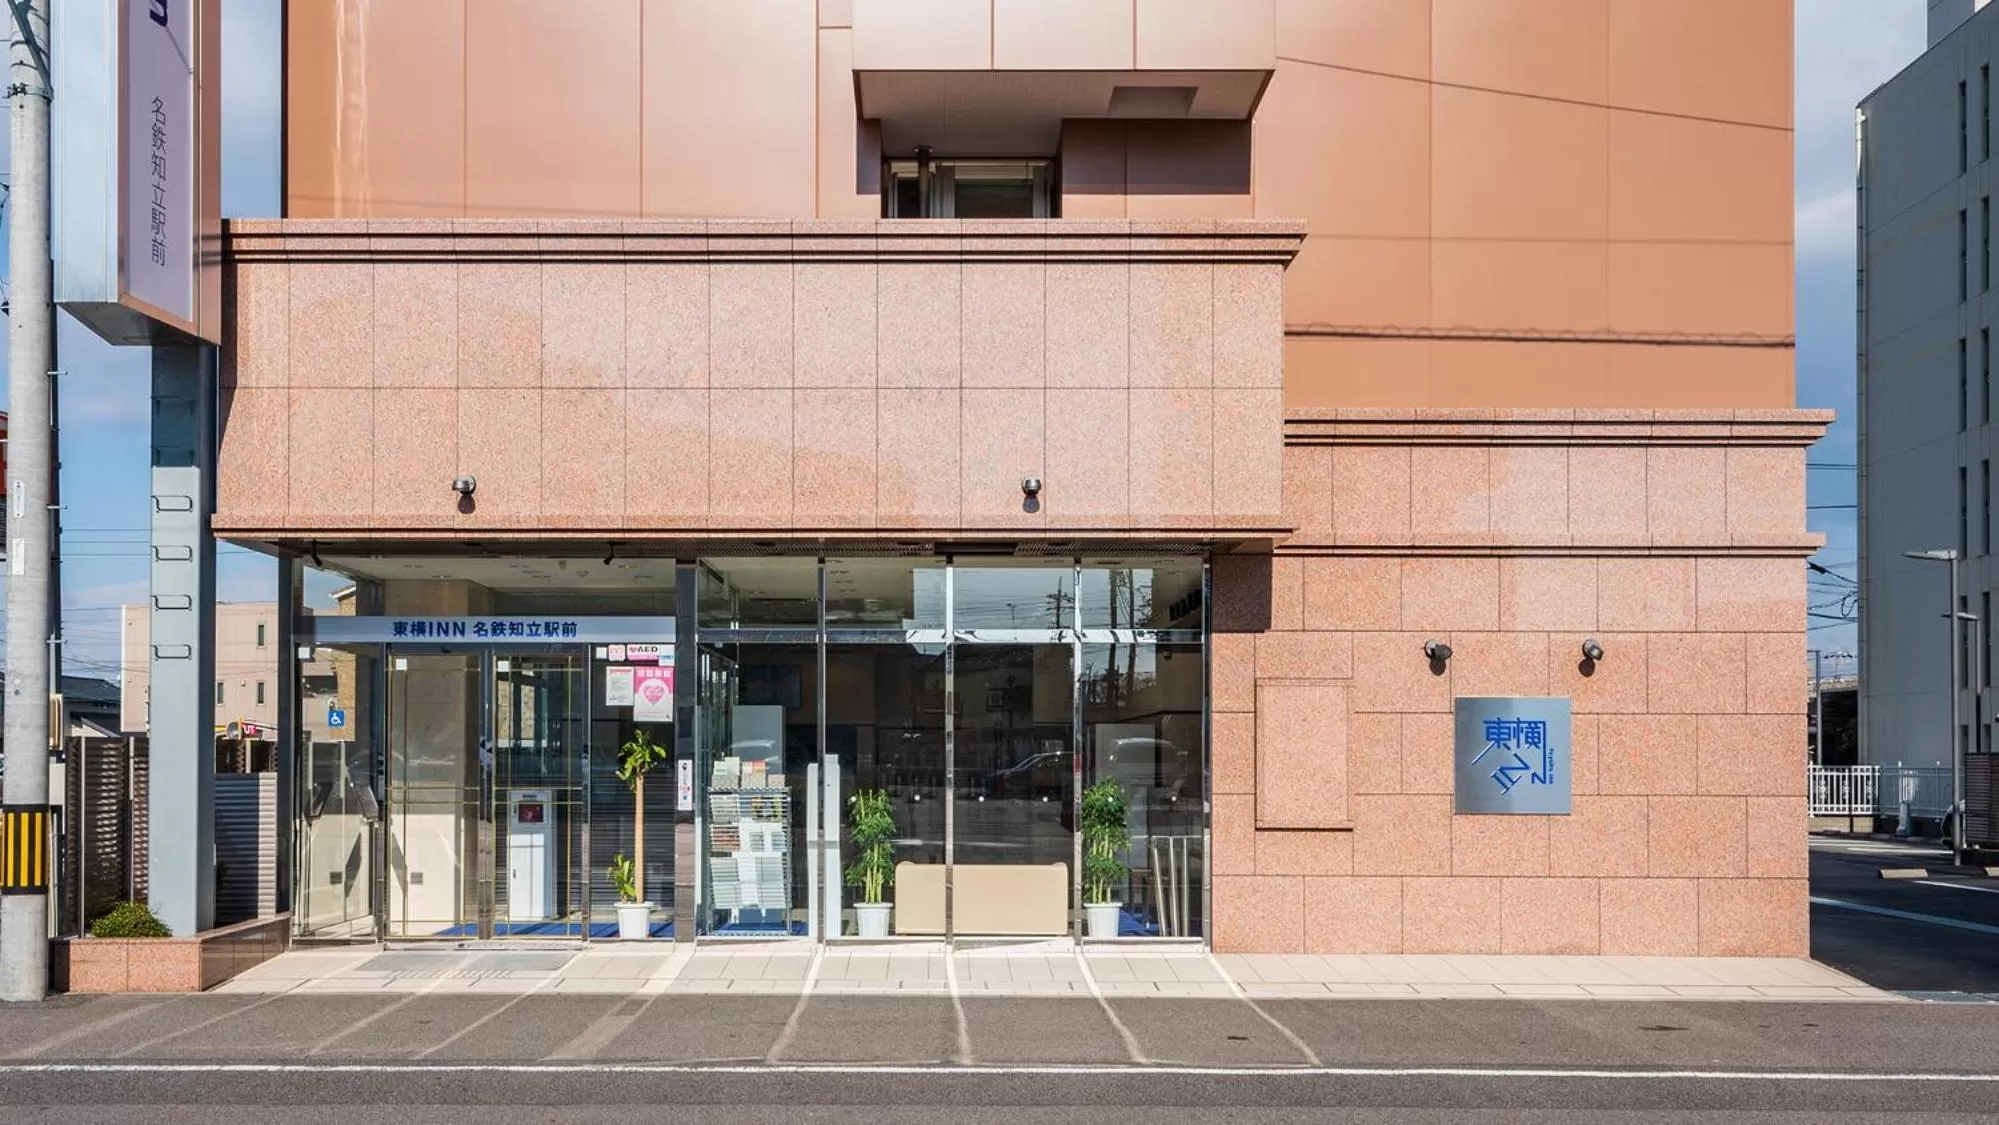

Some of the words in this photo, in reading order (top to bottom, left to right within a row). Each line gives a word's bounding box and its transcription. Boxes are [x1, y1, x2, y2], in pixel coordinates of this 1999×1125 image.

[151, 95, 167, 267] 名鉄知立駅前
[392, 620, 467, 638] 東横INN
[472, 620, 578, 638] 名鉄知立駅前
[637, 645, 658, 653] AED
